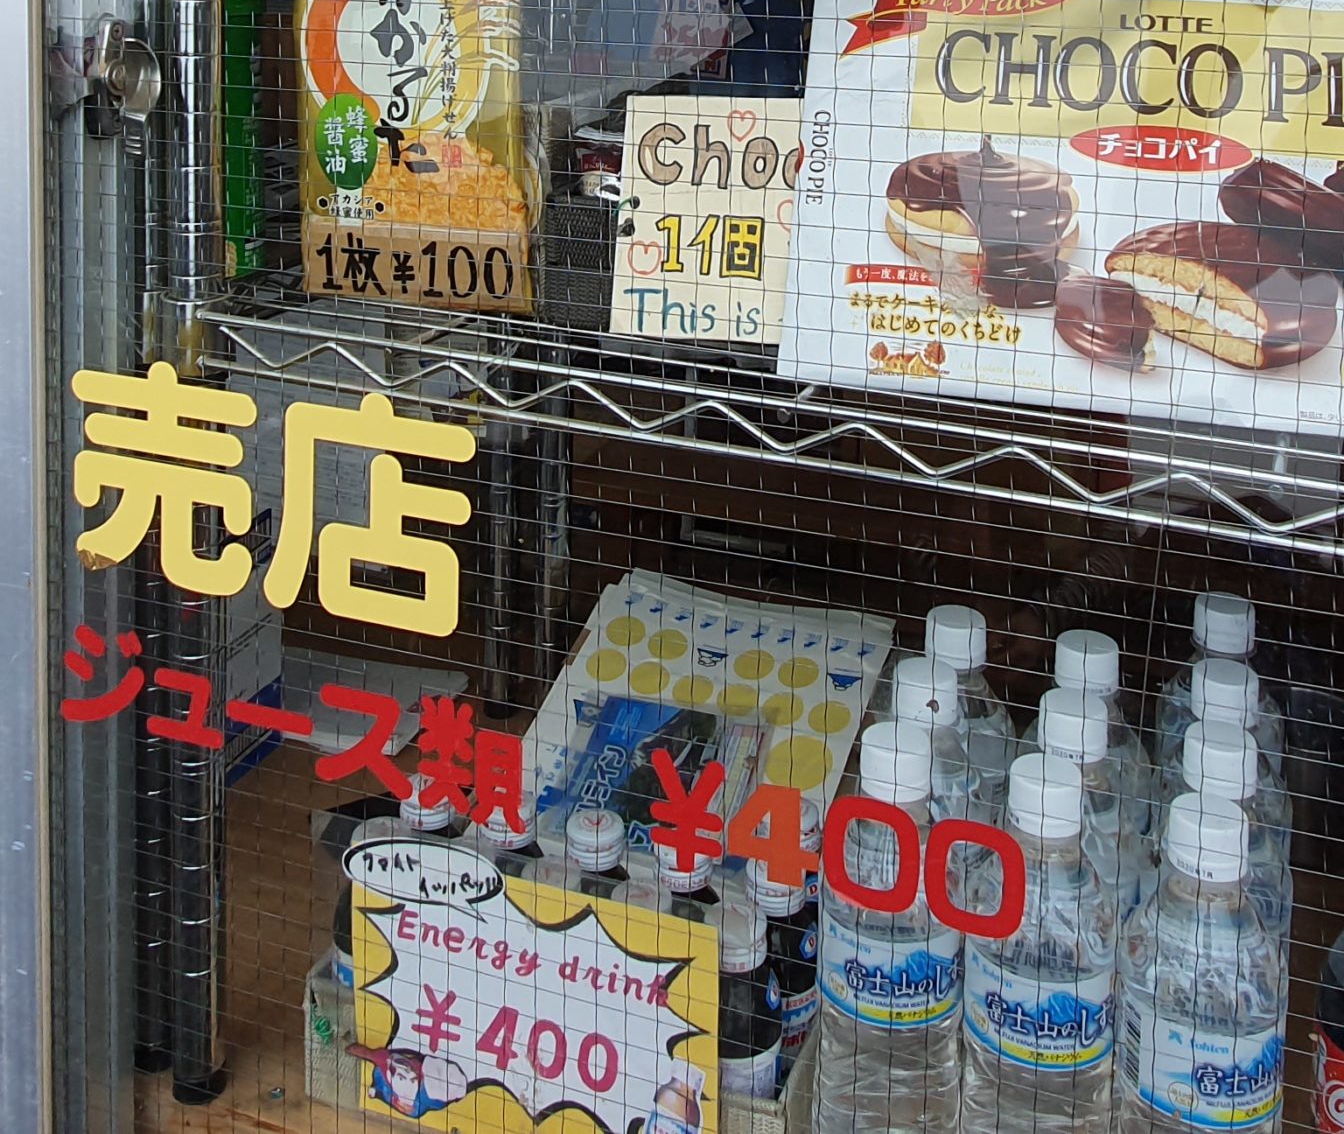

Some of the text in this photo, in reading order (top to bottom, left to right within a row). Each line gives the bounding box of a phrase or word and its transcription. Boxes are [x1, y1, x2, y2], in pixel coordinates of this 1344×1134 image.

[1119, 14, 1214, 35] LOTTE
[935, 27, 1245, 120] CHOCO
[322, 116, 347, 175] 醤油
[345, 105, 369, 164] 蜂蜜
[805, 110, 832, 205] CHOCO PIE
[1096, 133, 1224, 167] チョコパイ
[656, 213, 765, 281] 1個
[622, 287, 760, 338] This is
[870, 313, 1022, 345] はじめてのくちどけ
[71, 360, 477, 637] 売店
[59, 623, 527, 835] ジュース類
[649, 747, 1027, 940] ¥400
[396, 909, 672, 1008] Energy drink
[410, 983, 620, 1094] ¥400
